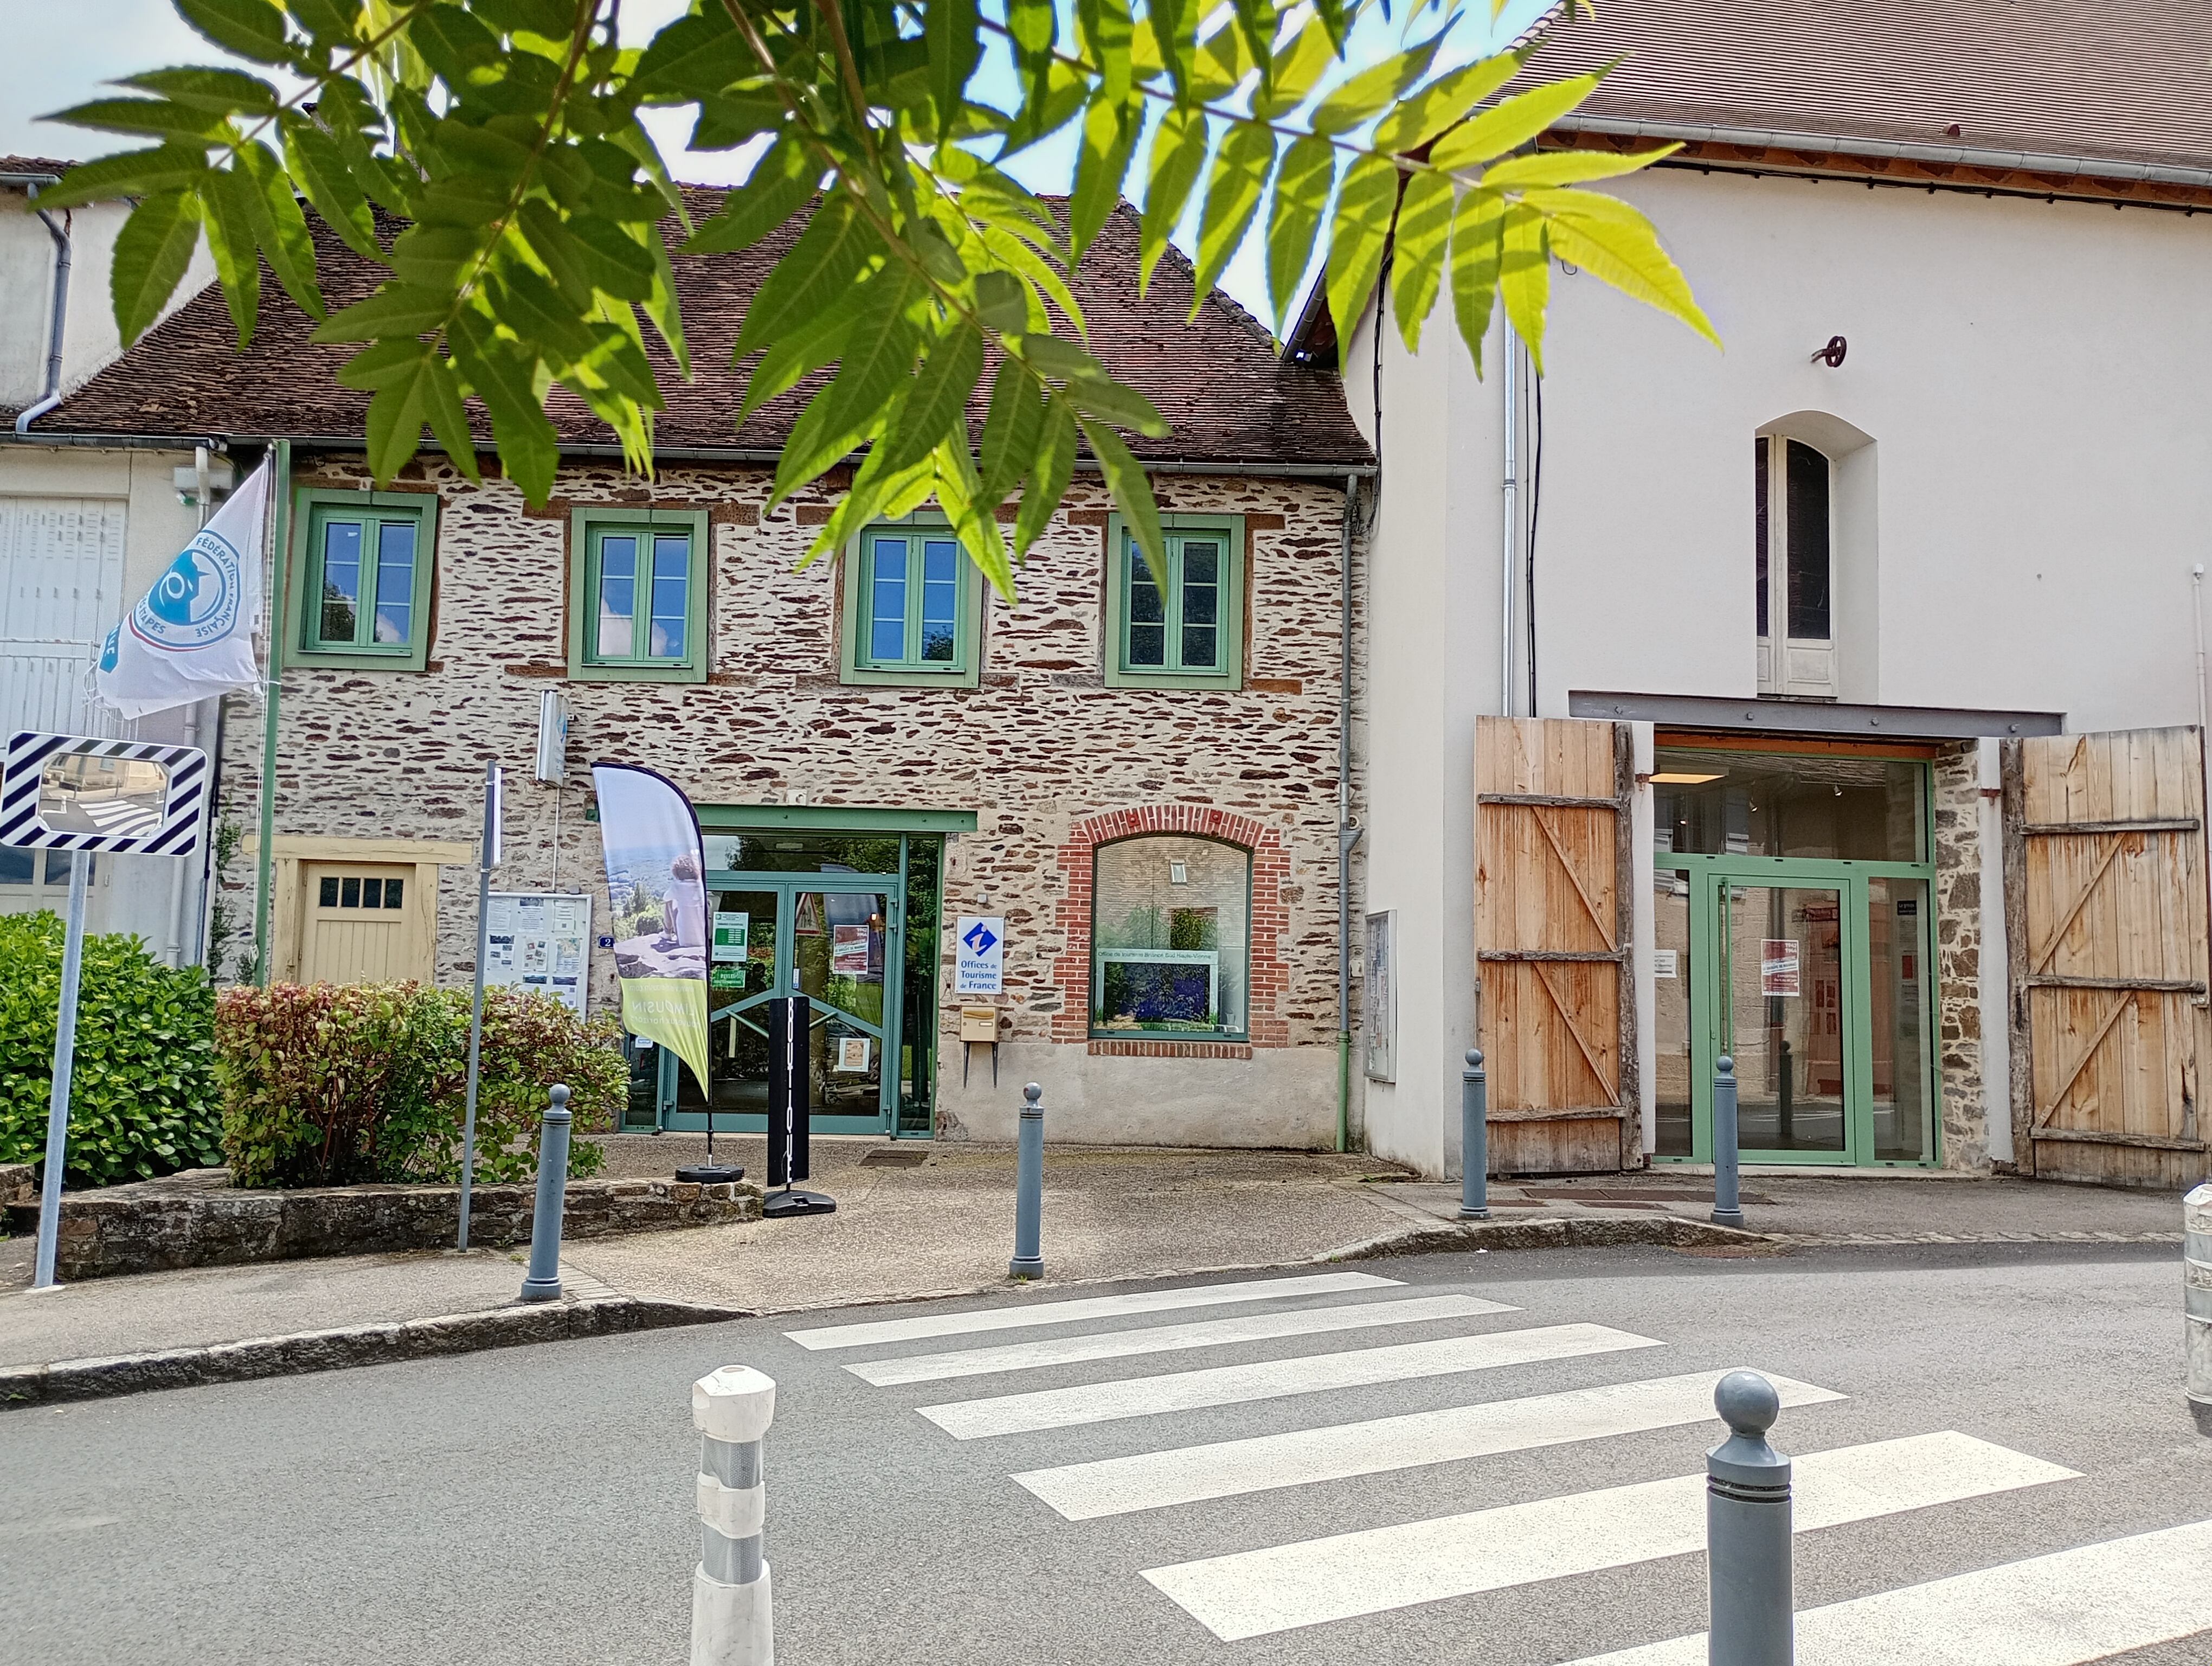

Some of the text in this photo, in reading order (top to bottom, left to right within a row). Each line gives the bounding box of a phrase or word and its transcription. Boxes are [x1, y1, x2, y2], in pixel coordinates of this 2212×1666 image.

[195, 537, 235, 637] FÉDÉRATION FRANÇAISE
[605, 938, 611, 947] 2
[961, 960, 989, 969] Offices
[961, 970, 997, 979] Tourisme
[969, 981, 997, 990] France
